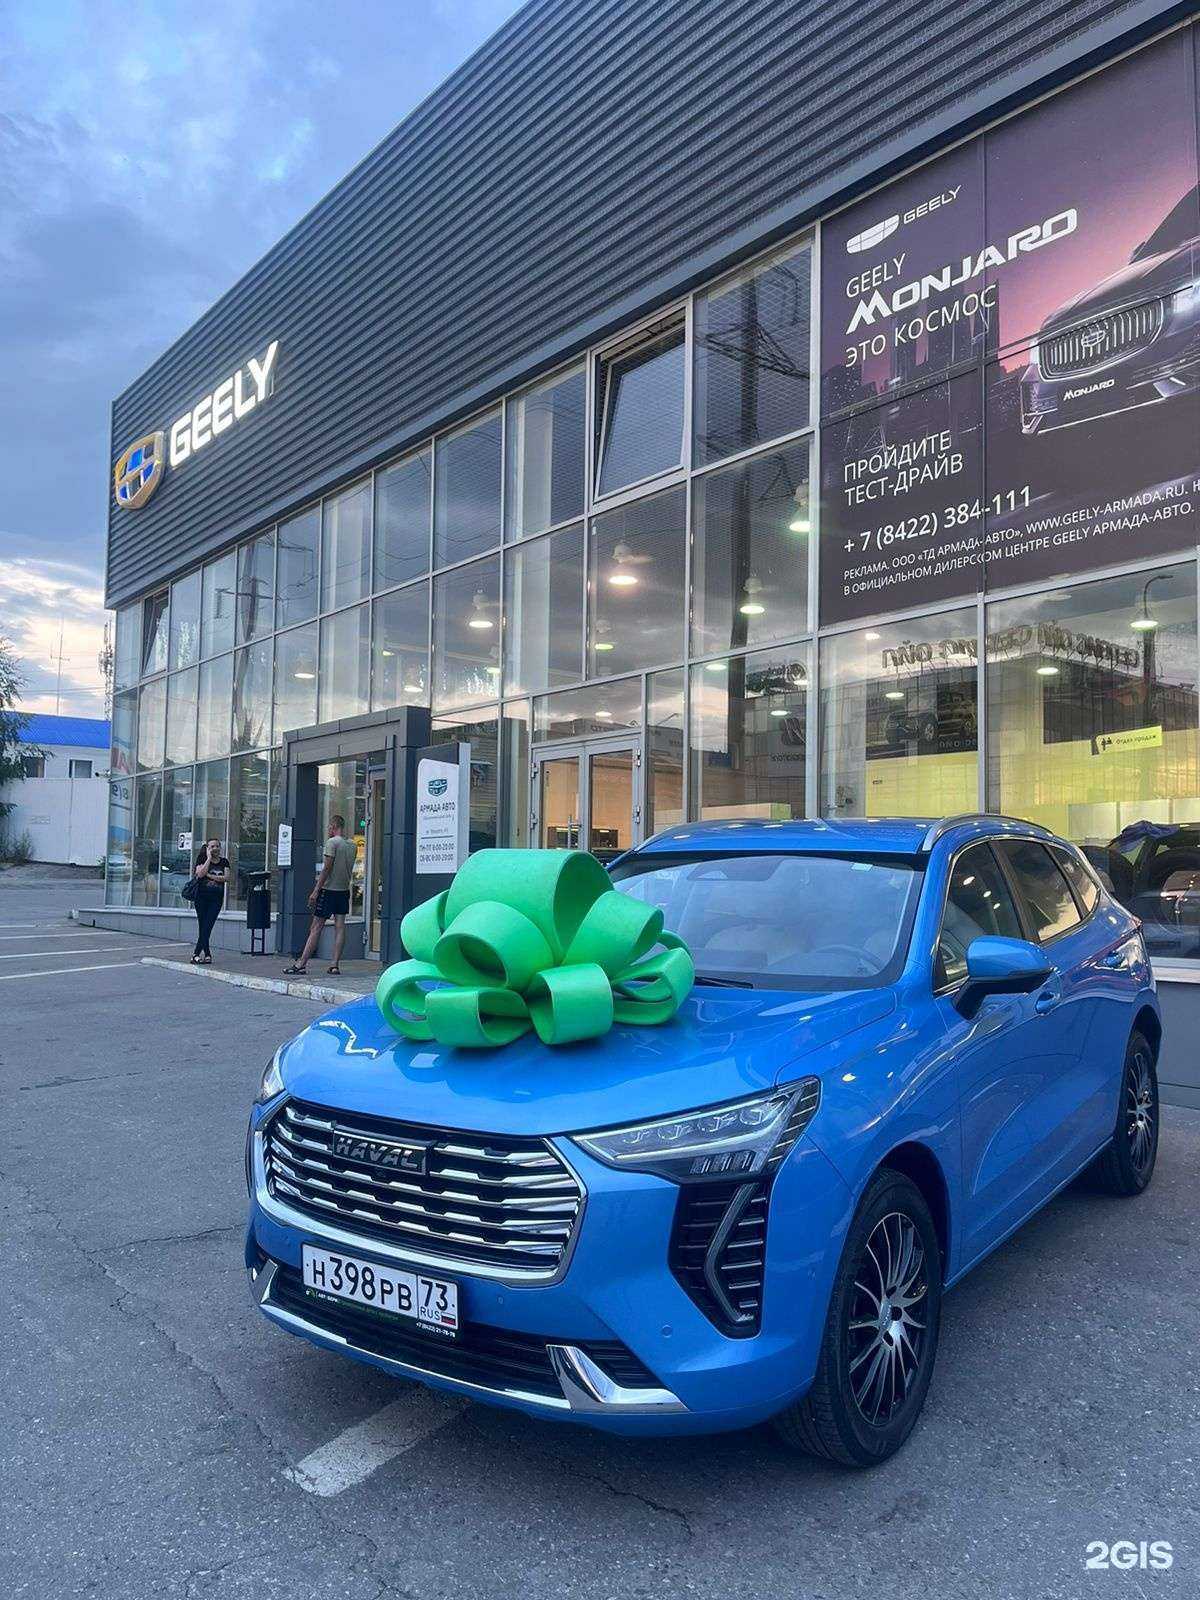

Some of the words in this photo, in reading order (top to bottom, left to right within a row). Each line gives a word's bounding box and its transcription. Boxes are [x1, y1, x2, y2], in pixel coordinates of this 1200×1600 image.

[903, 184, 962, 225] GEELY
[845, 208, 1078, 335] MONJARO
[846, 253, 906, 299] GEELY
[845, 334, 886, 368] ЭТО
[895, 284, 998, 347] КОСМОС
[170, 340, 279, 468] GEELY
[1063, 379, 1115, 401] MONJARO
[844, 430, 952, 483] ПРОЙДИТЕ
[844, 453, 963, 506] ТЕСТ-ДРАЙВ
[843, 560, 890, 580] РЕКЛАМА.
[892, 553, 916, 568] ООО
[1025, 484, 1189, 535] WWW.GEELY-ARMADA.RU.
[860, 530, 872, 552] 7
[876, 512, 938, 550] (8422)
[943, 485, 1031, 529] 384-111
[843, 586, 850, 596] В
[852, 565, 932, 593] ОФИЦИАЛЬНОМ
[1005, 536, 1050, 558] ЦЕНТРЕ
[1052, 526, 1091, 547] GEELY
[1092, 502, 1195, 536] АРМАДА-АВТО.
[420, 803, 441, 814] АРМАДА
[442, 800, 456, 812] АВТО
[335, 1137, 418, 1169] HAVAL
[312, 1256, 412, 1311] Н398РВ
[421, 1279, 448, 1311] 73
[420, 1307, 441, 1321] RUS
